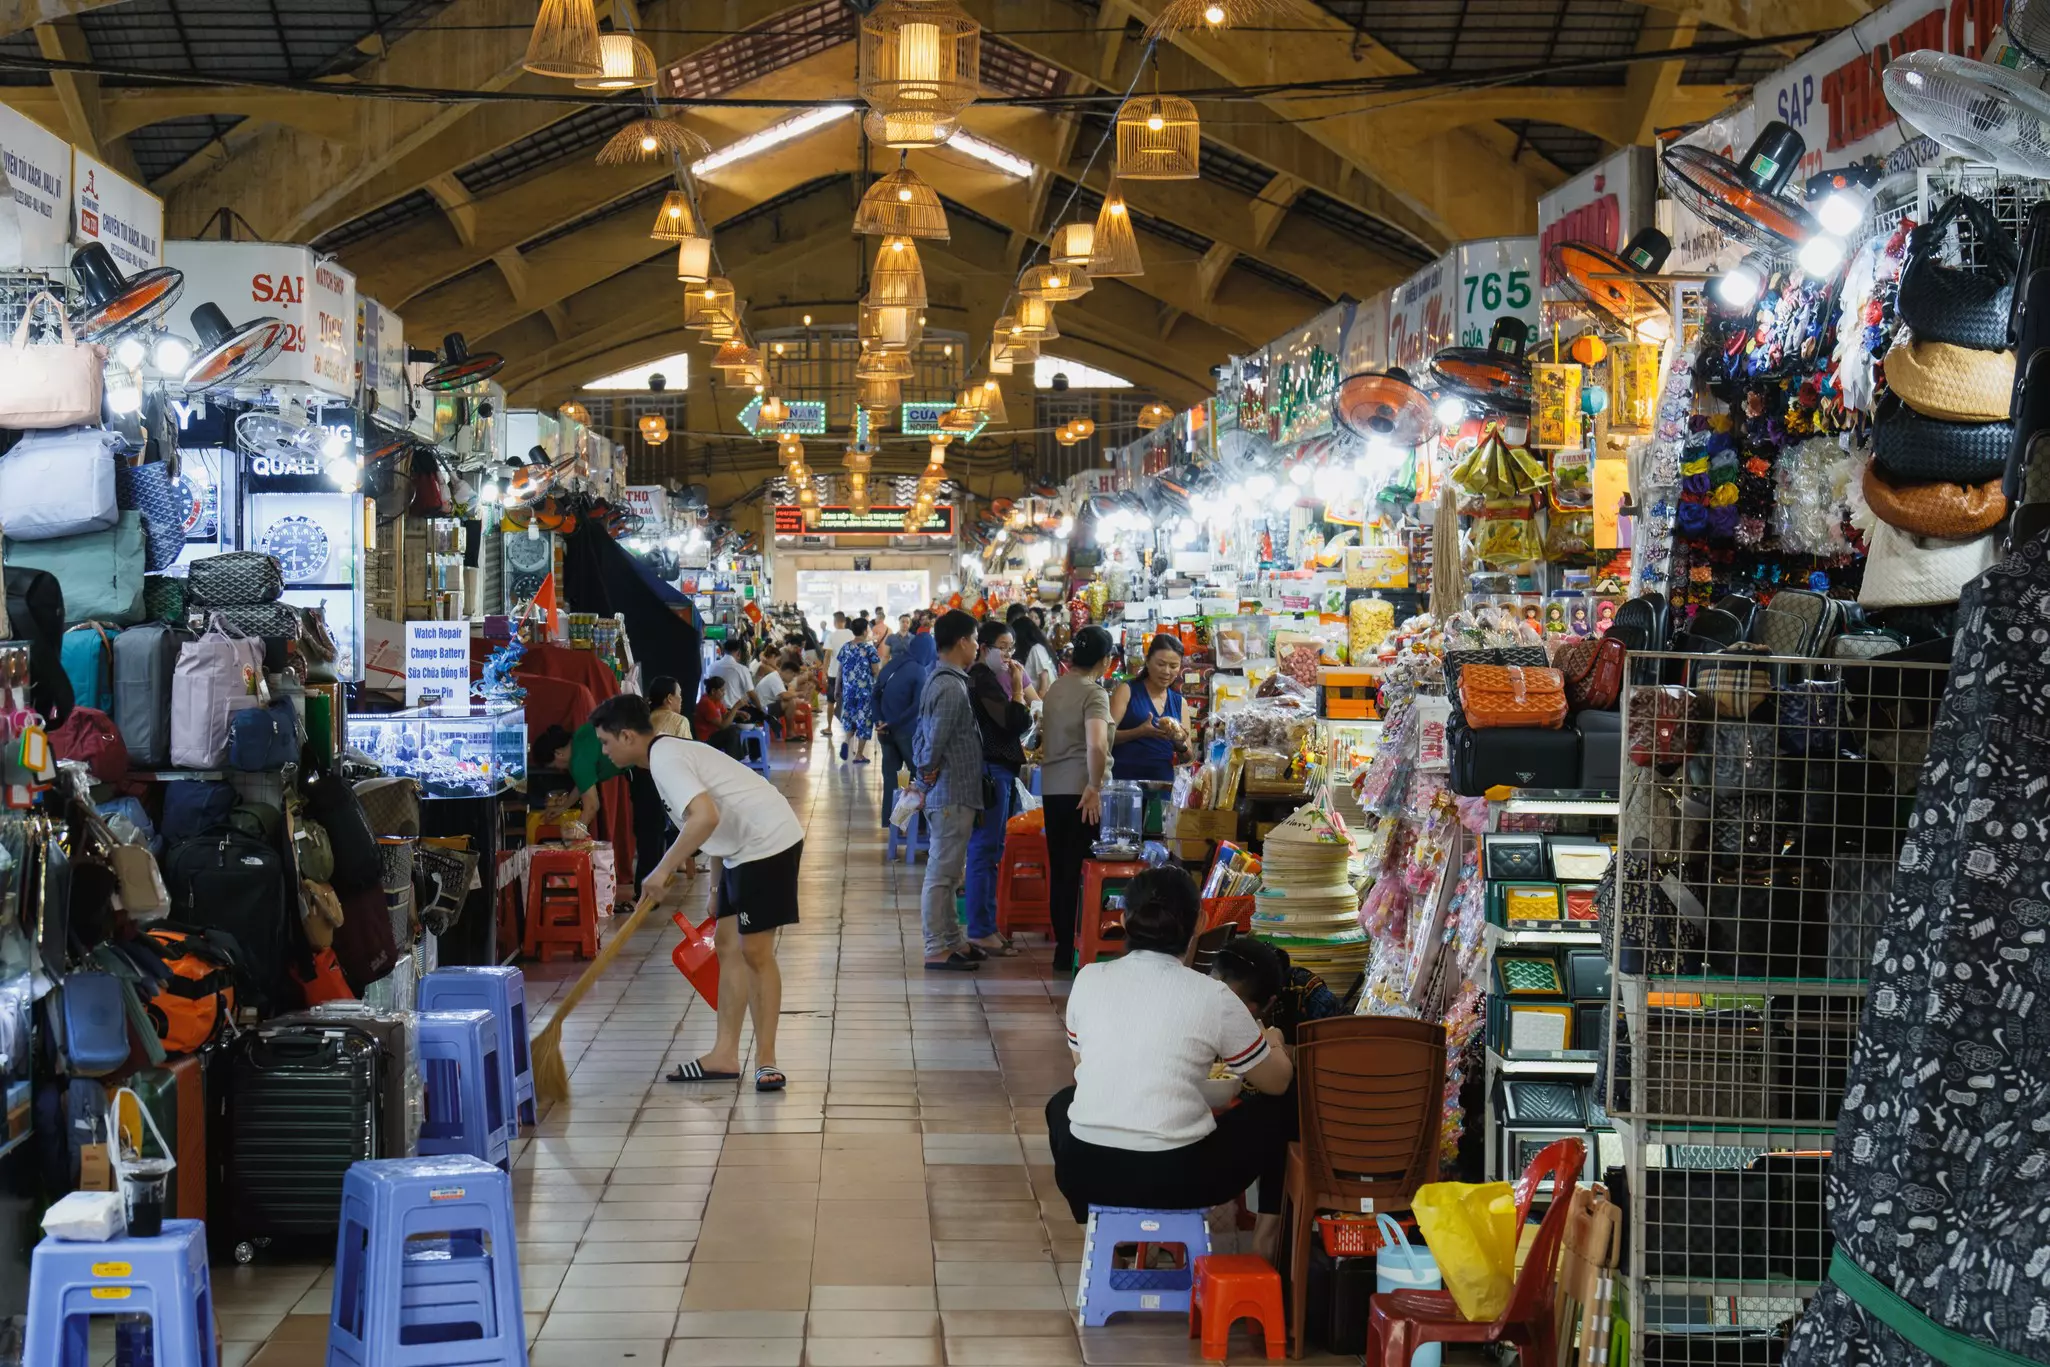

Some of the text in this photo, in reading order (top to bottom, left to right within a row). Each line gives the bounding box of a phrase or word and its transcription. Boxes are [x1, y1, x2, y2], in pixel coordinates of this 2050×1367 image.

[3, 149, 18, 176] UYÊN
[1464, 271, 1532, 314] 765
[1462, 322, 1484, 348] CỬA
[789, 408, 818, 418] NAM
[910, 423, 941, 431] NORTHE
[253, 456, 330, 476] QUALI
[2018, 583, 2041, 608] NIKE
[414, 627, 462, 640] Watch Repair
[410, 647, 466, 660] Change Battery
[1985, 660, 2008, 686] NIKE
[441, 687, 454, 699] Pin
[1930, 758, 1950, 786] NIKE
[2025, 775, 2049, 800] NIKE
[1999, 861, 2020, 889] NIKE
[1968, 916, 1996, 941] NIKE
